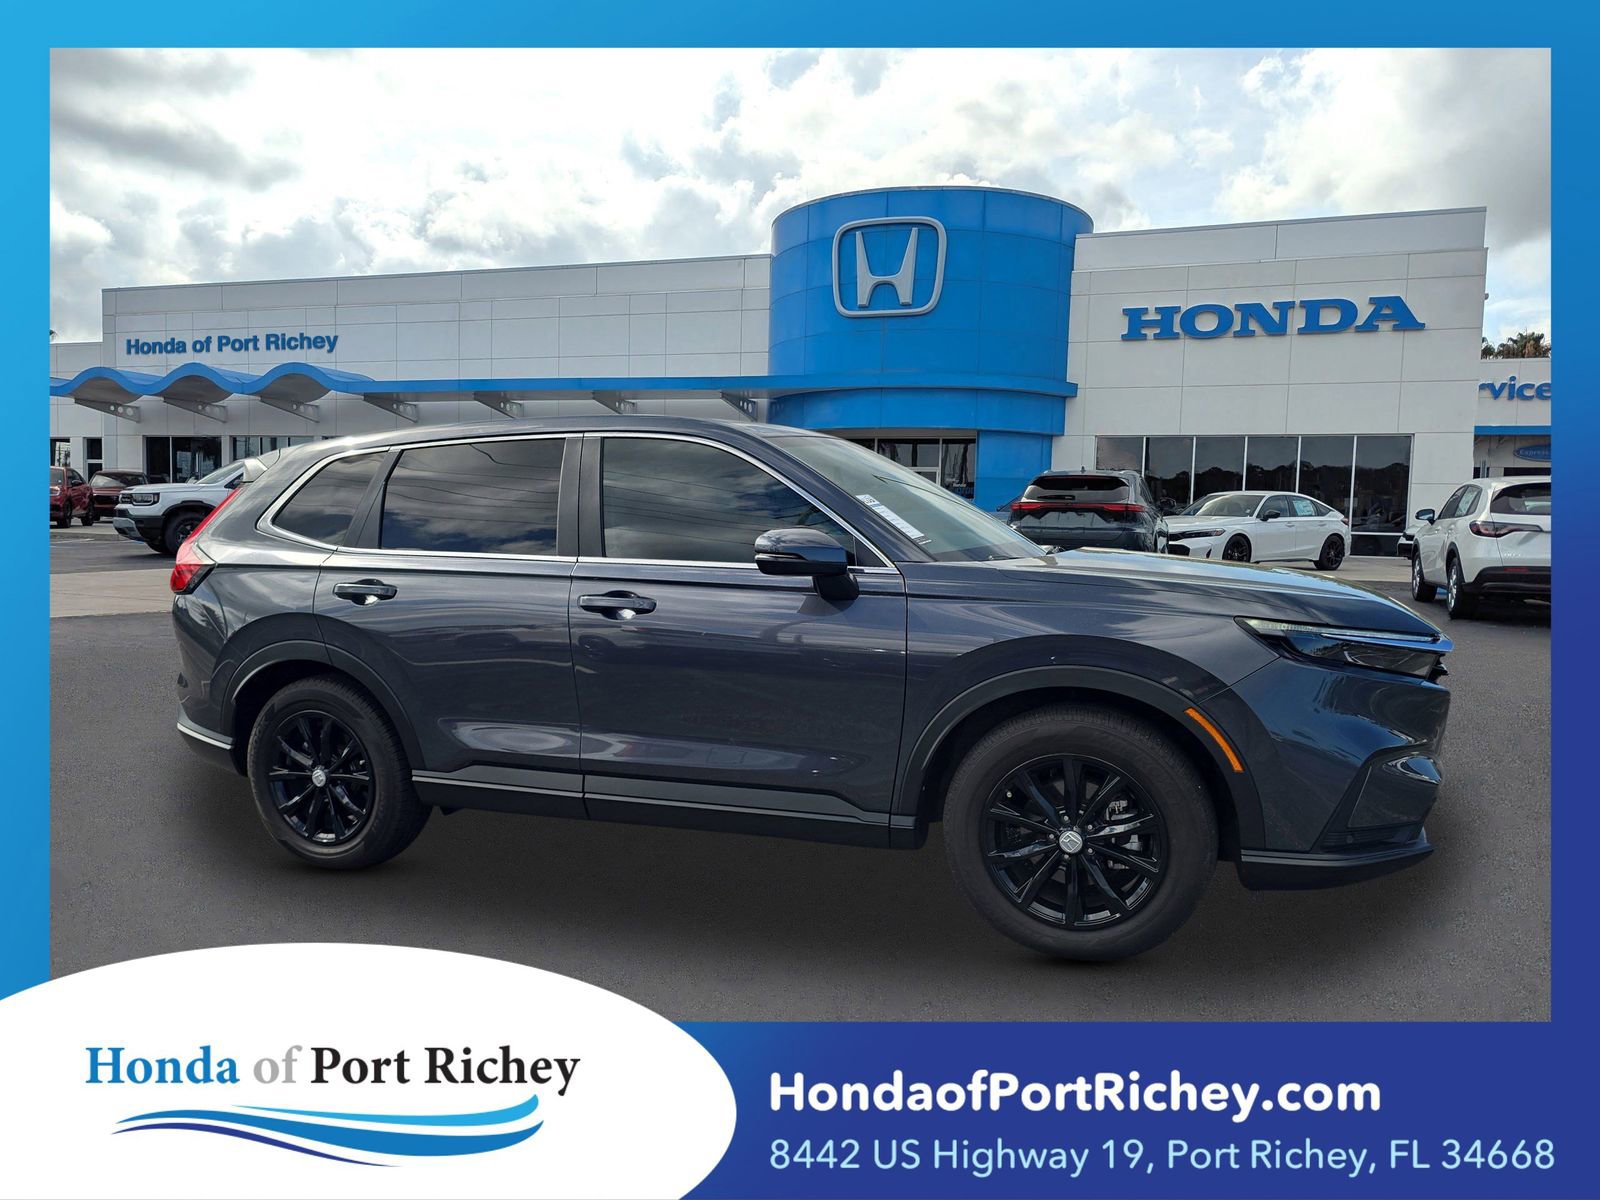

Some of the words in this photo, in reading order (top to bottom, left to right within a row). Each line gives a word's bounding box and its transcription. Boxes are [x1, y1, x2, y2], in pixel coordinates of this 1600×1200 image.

[1121, 295, 1426, 341] HONDA
[126, 338, 187, 355] Honda
[192, 336, 212, 353] of
[217, 335, 259, 352] Port
[265, 332, 338, 353] Richey
